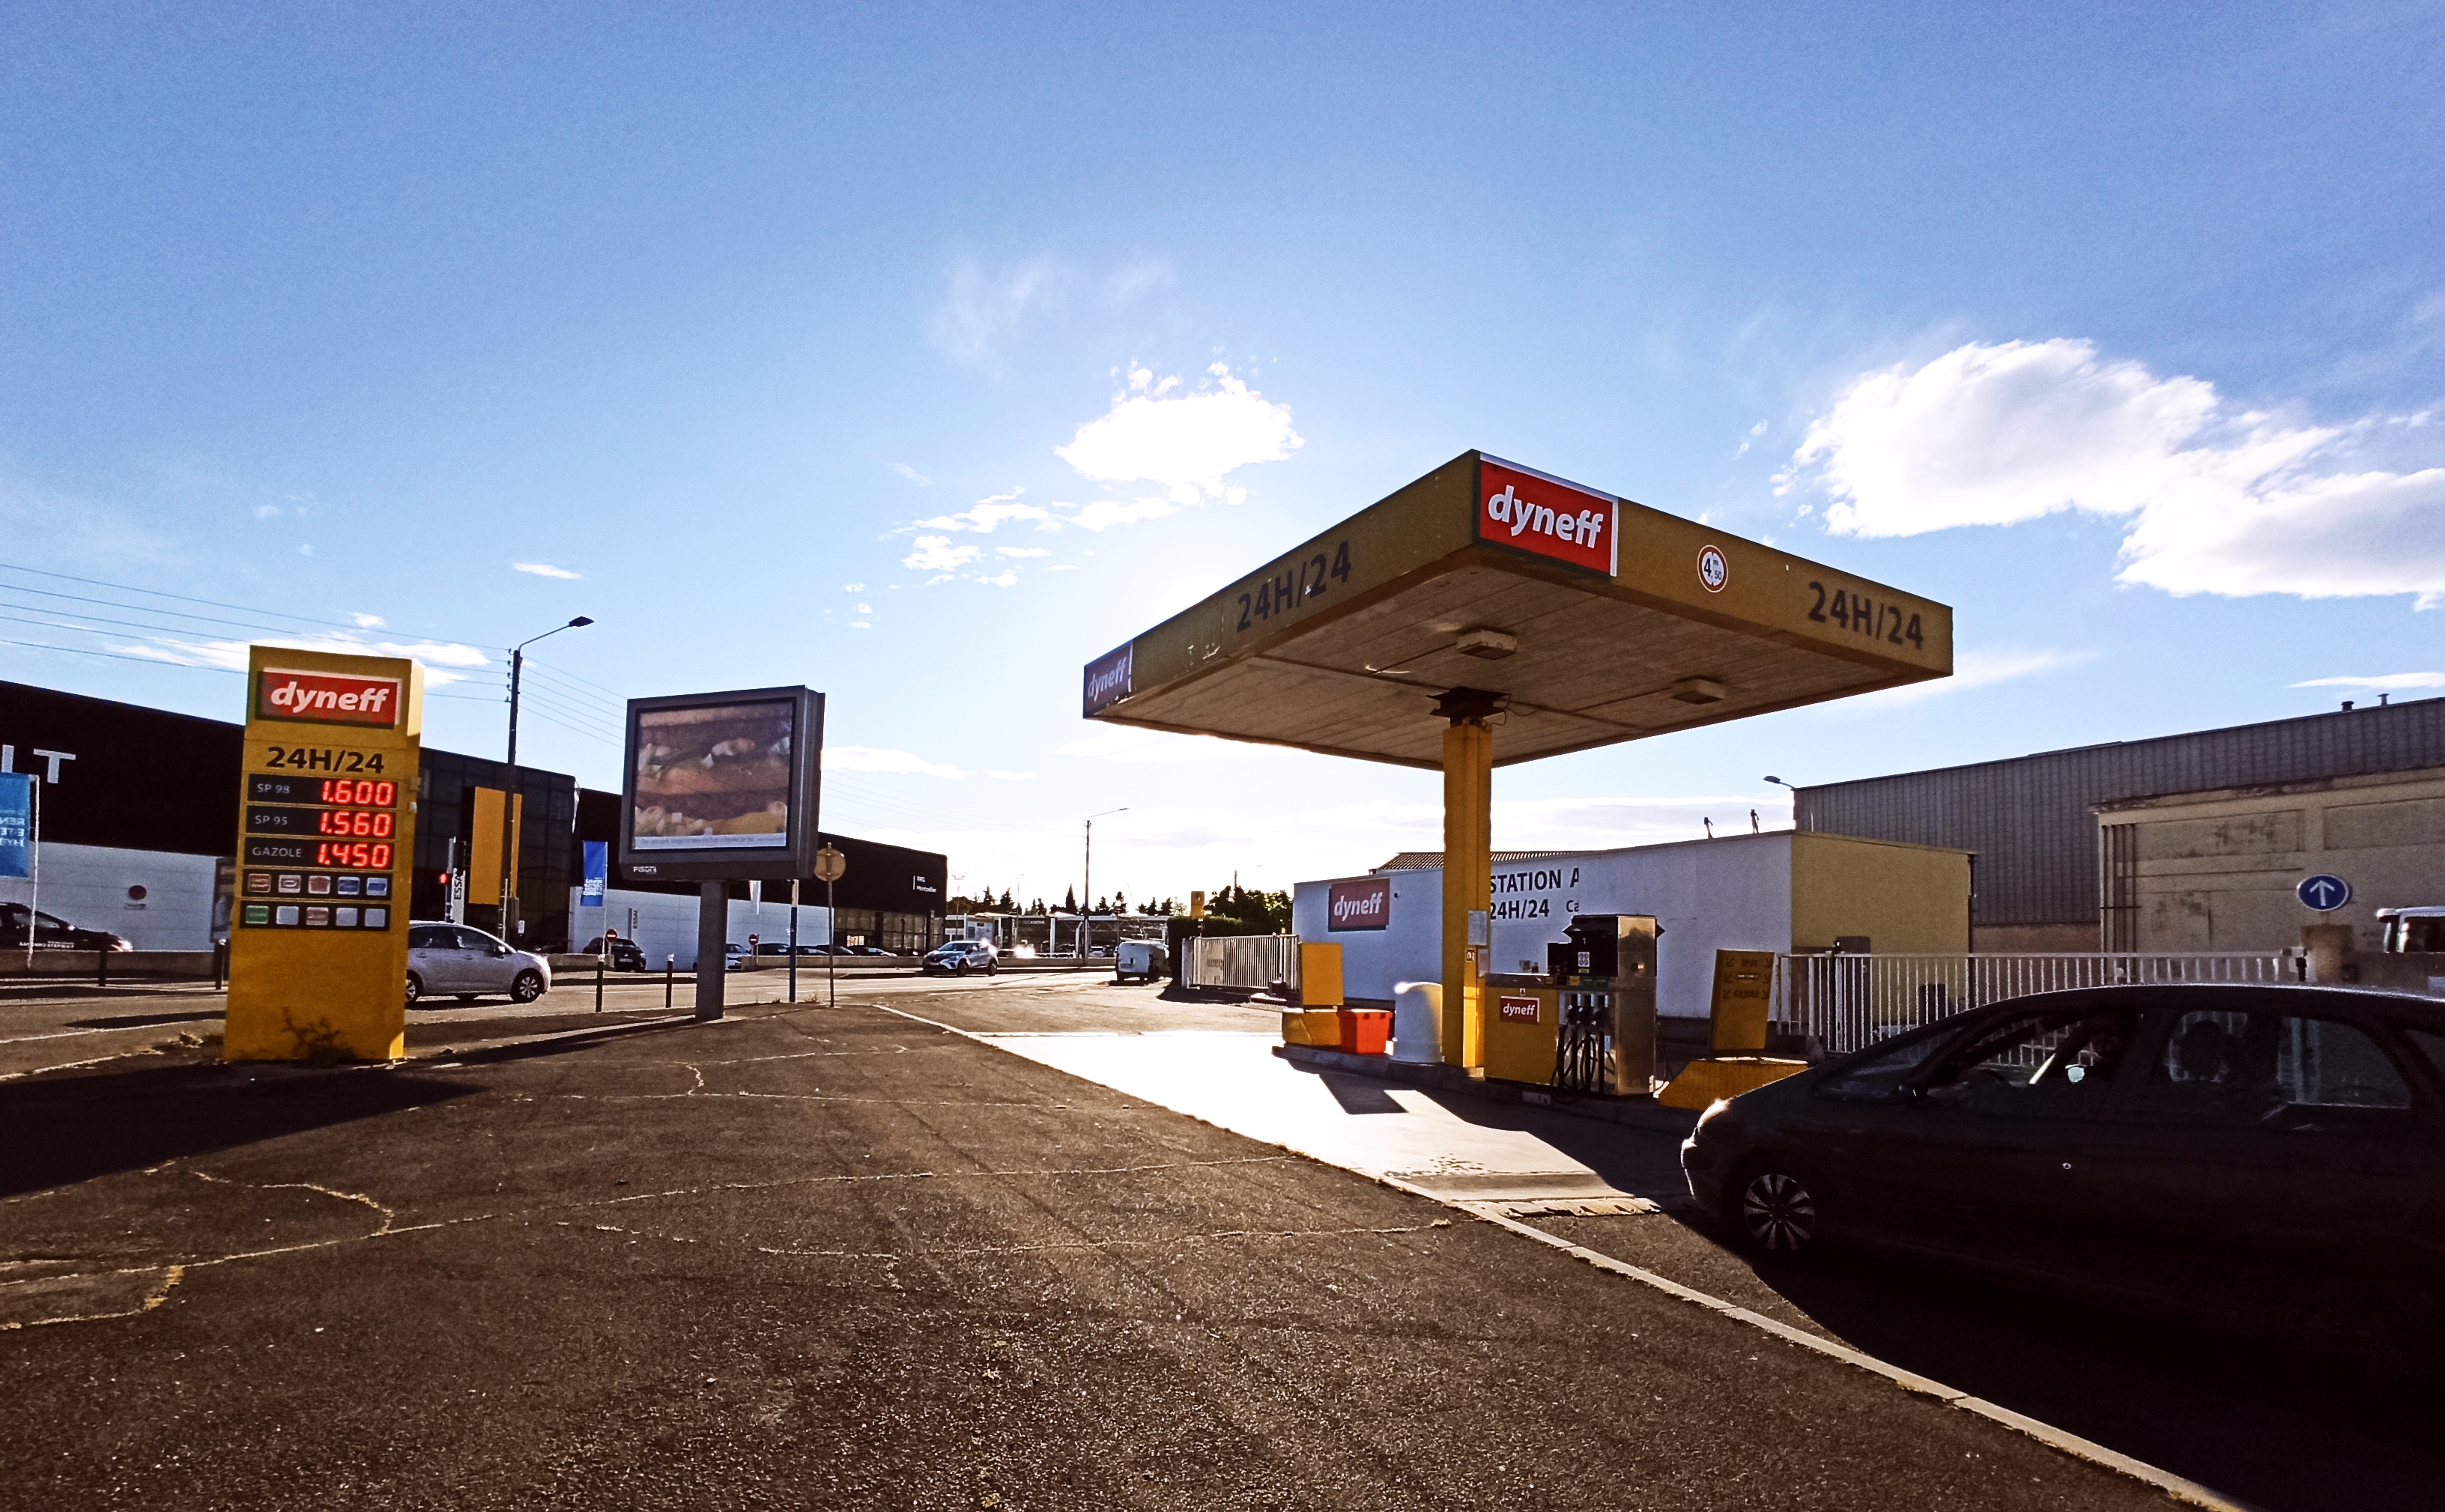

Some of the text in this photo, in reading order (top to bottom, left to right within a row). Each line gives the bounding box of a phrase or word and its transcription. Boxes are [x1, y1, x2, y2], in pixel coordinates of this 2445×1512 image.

[1488, 485, 1604, 548] dyneff
[1237, 540, 1352, 633] 24H/24
[1808, 580, 1924, 651] 24H/24
[1088, 656, 1127, 702] dyneff
[270, 681, 390, 714] dyneff
[265, 746, 385, 774] 24H/24
[257, 780, 395, 807] SP 98 1.600
[255, 811, 393, 838] SP 95 1.560
[252, 842, 390, 869] GAZOLE 1.450
[1491, 869, 1562, 894] STATION
[1333, 891, 1384, 922] dyneff
[1491, 899, 1550, 920] 24H/24
[1503, 1003, 1536, 1017] dyneff
